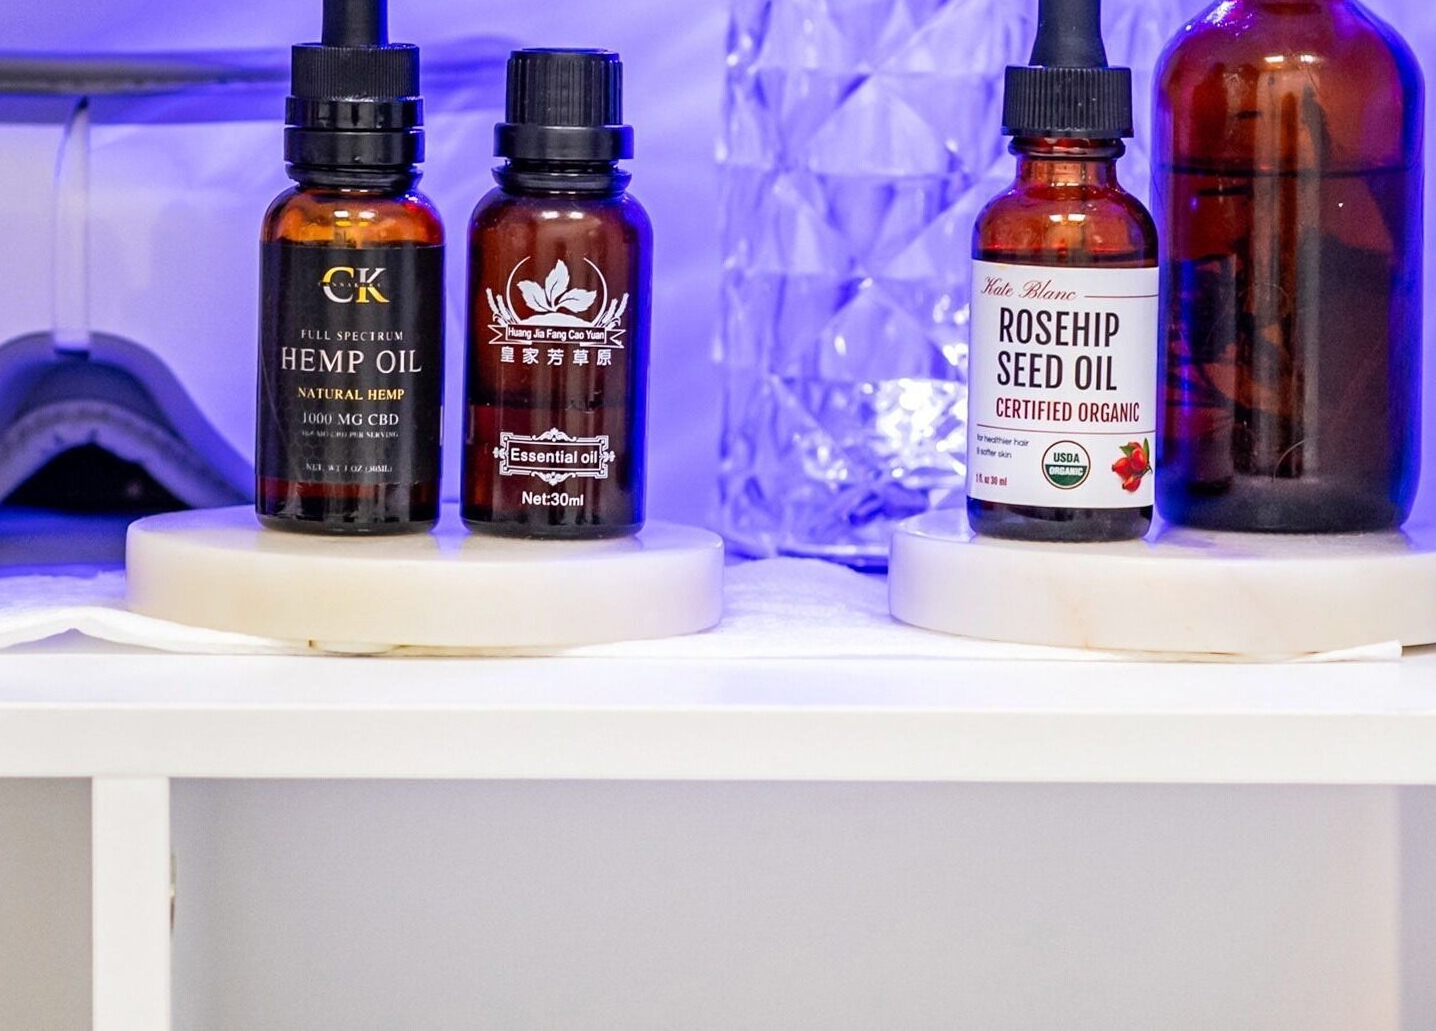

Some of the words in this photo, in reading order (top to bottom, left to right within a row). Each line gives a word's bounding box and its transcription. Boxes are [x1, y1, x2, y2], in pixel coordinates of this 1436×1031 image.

[322, 266, 391, 304] CK
[981, 275, 1014, 297] Kate
[1018, 279, 1078, 301] Blanc
[508, 326, 532, 340] Huang
[533, 328, 545, 339] Jia
[546, 328, 567, 342] Fang
[568, 329, 585, 340] Cao
[585, 329, 605, 340] Yuan
[999, 306, 1120, 348] ROSEHIP
[301, 329, 332, 341] FULL
[336, 330, 404, 342] SPECTRUM
[281, 346, 365, 374] HEMP
[376, 349, 423, 374] OIL
[500, 345, 612, 367] 皇家芳草原
[997, 350, 1064, 390] SEED
[1075, 355, 1118, 391] OIL
[297, 386, 364, 401] NATURAL
[367, 388, 405, 401] HEMP
[996, 397, 1073, 422] CERTIFIED
[1078, 401, 1141, 423] ORGANIC
[302, 411, 333, 425] 1000
[337, 413, 363, 426] MG
[367, 413, 400, 427] CBD
[366, 431, 399, 439] SERVING
[984, 434, 1013, 445] healthier
[1013, 437, 1030, 447] hair
[510, 447, 578, 464] Essential
[580, 450, 598, 464] oil
[997, 450, 1013, 459] skin
[1053, 451, 1081, 464] USDA
[1048, 466, 1084, 476] ORGANIC
[999, 476, 1008, 486] ml
[521, 490, 585, 507] Net:30ml
